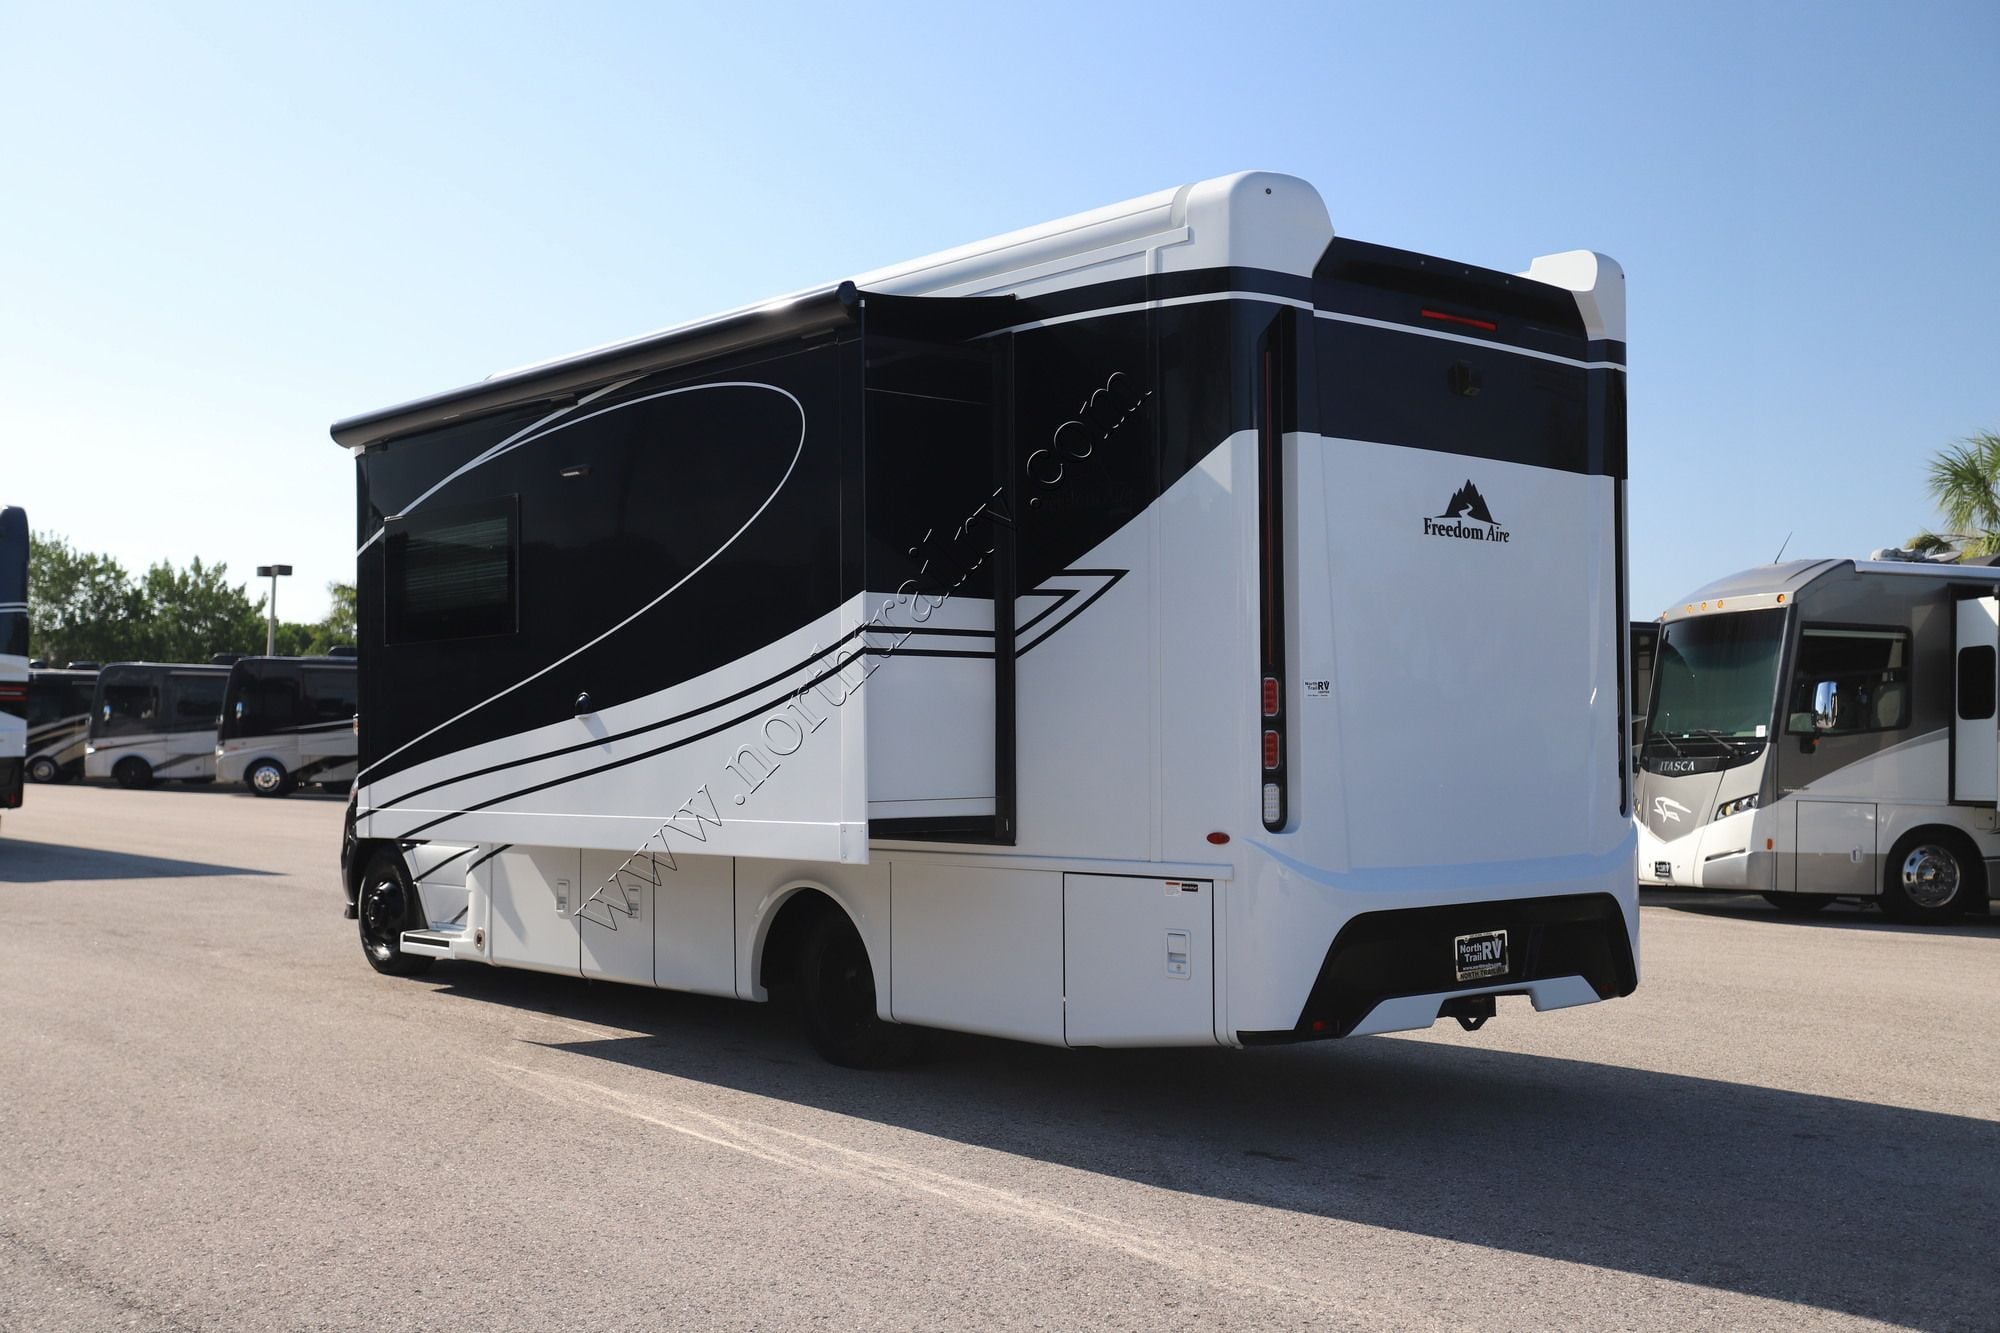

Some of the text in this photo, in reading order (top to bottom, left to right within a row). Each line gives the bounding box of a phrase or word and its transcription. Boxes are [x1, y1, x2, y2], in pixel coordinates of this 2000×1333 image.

[1423, 517, 1510, 543] Freedom Aire
[1317, 680, 1330, 691] RV
[1659, 760, 1695, 771] ITASCA
[1460, 942, 1482, 954] North
[1482, 938, 1502, 961] RV
[1464, 951, 1482, 963] Trail
